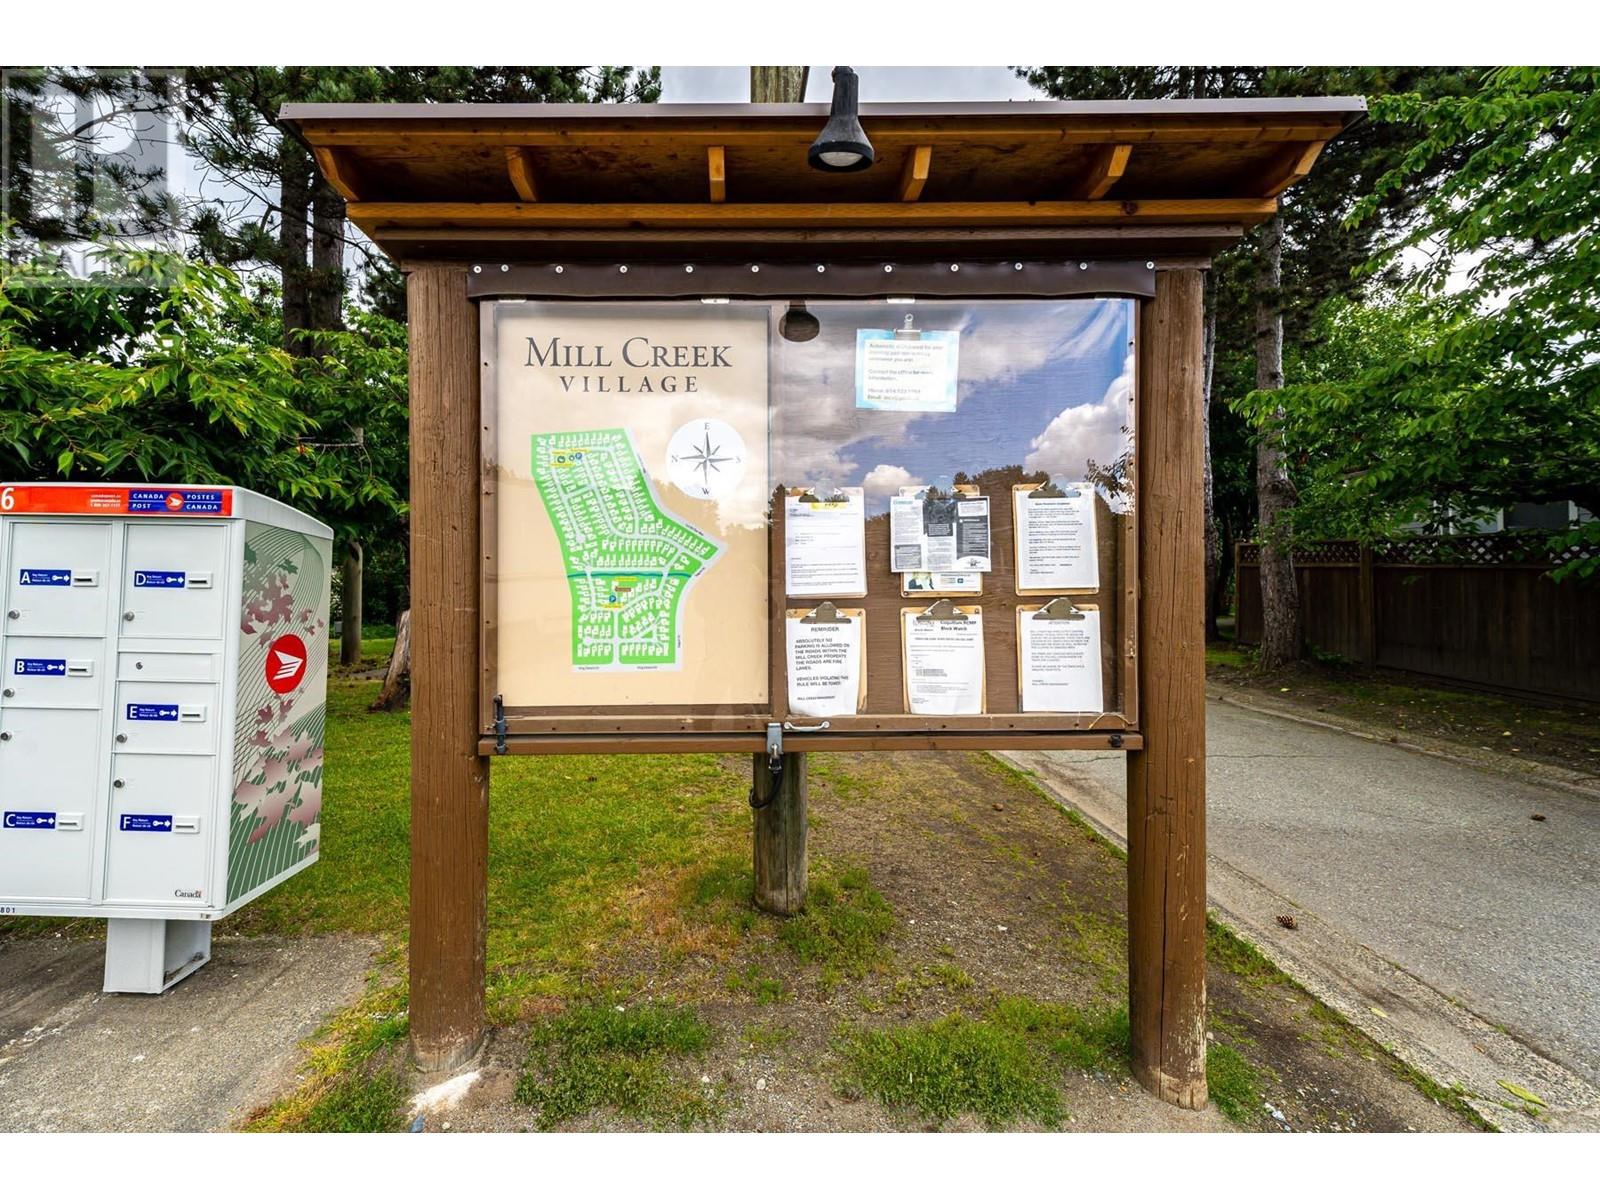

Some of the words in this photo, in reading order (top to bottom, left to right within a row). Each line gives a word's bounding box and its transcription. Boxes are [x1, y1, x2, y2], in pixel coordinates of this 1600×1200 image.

[524, 336, 612, 368] MILL
[622, 336, 733, 368] CREEK
[559, 375, 698, 393] VILLAGE
[704, 423, 710, 431] E
[671, 455, 680, 463] N
[702, 487, 712, 496] W
[1, 487, 14, 510] 6
[20, 571, 31, 584] A
[136, 573, 146, 586] D
[17, 661, 25, 673] B
[130, 706, 138, 719] E
[6, 813, 16, 827] C
[123, 816, 131, 829] F
